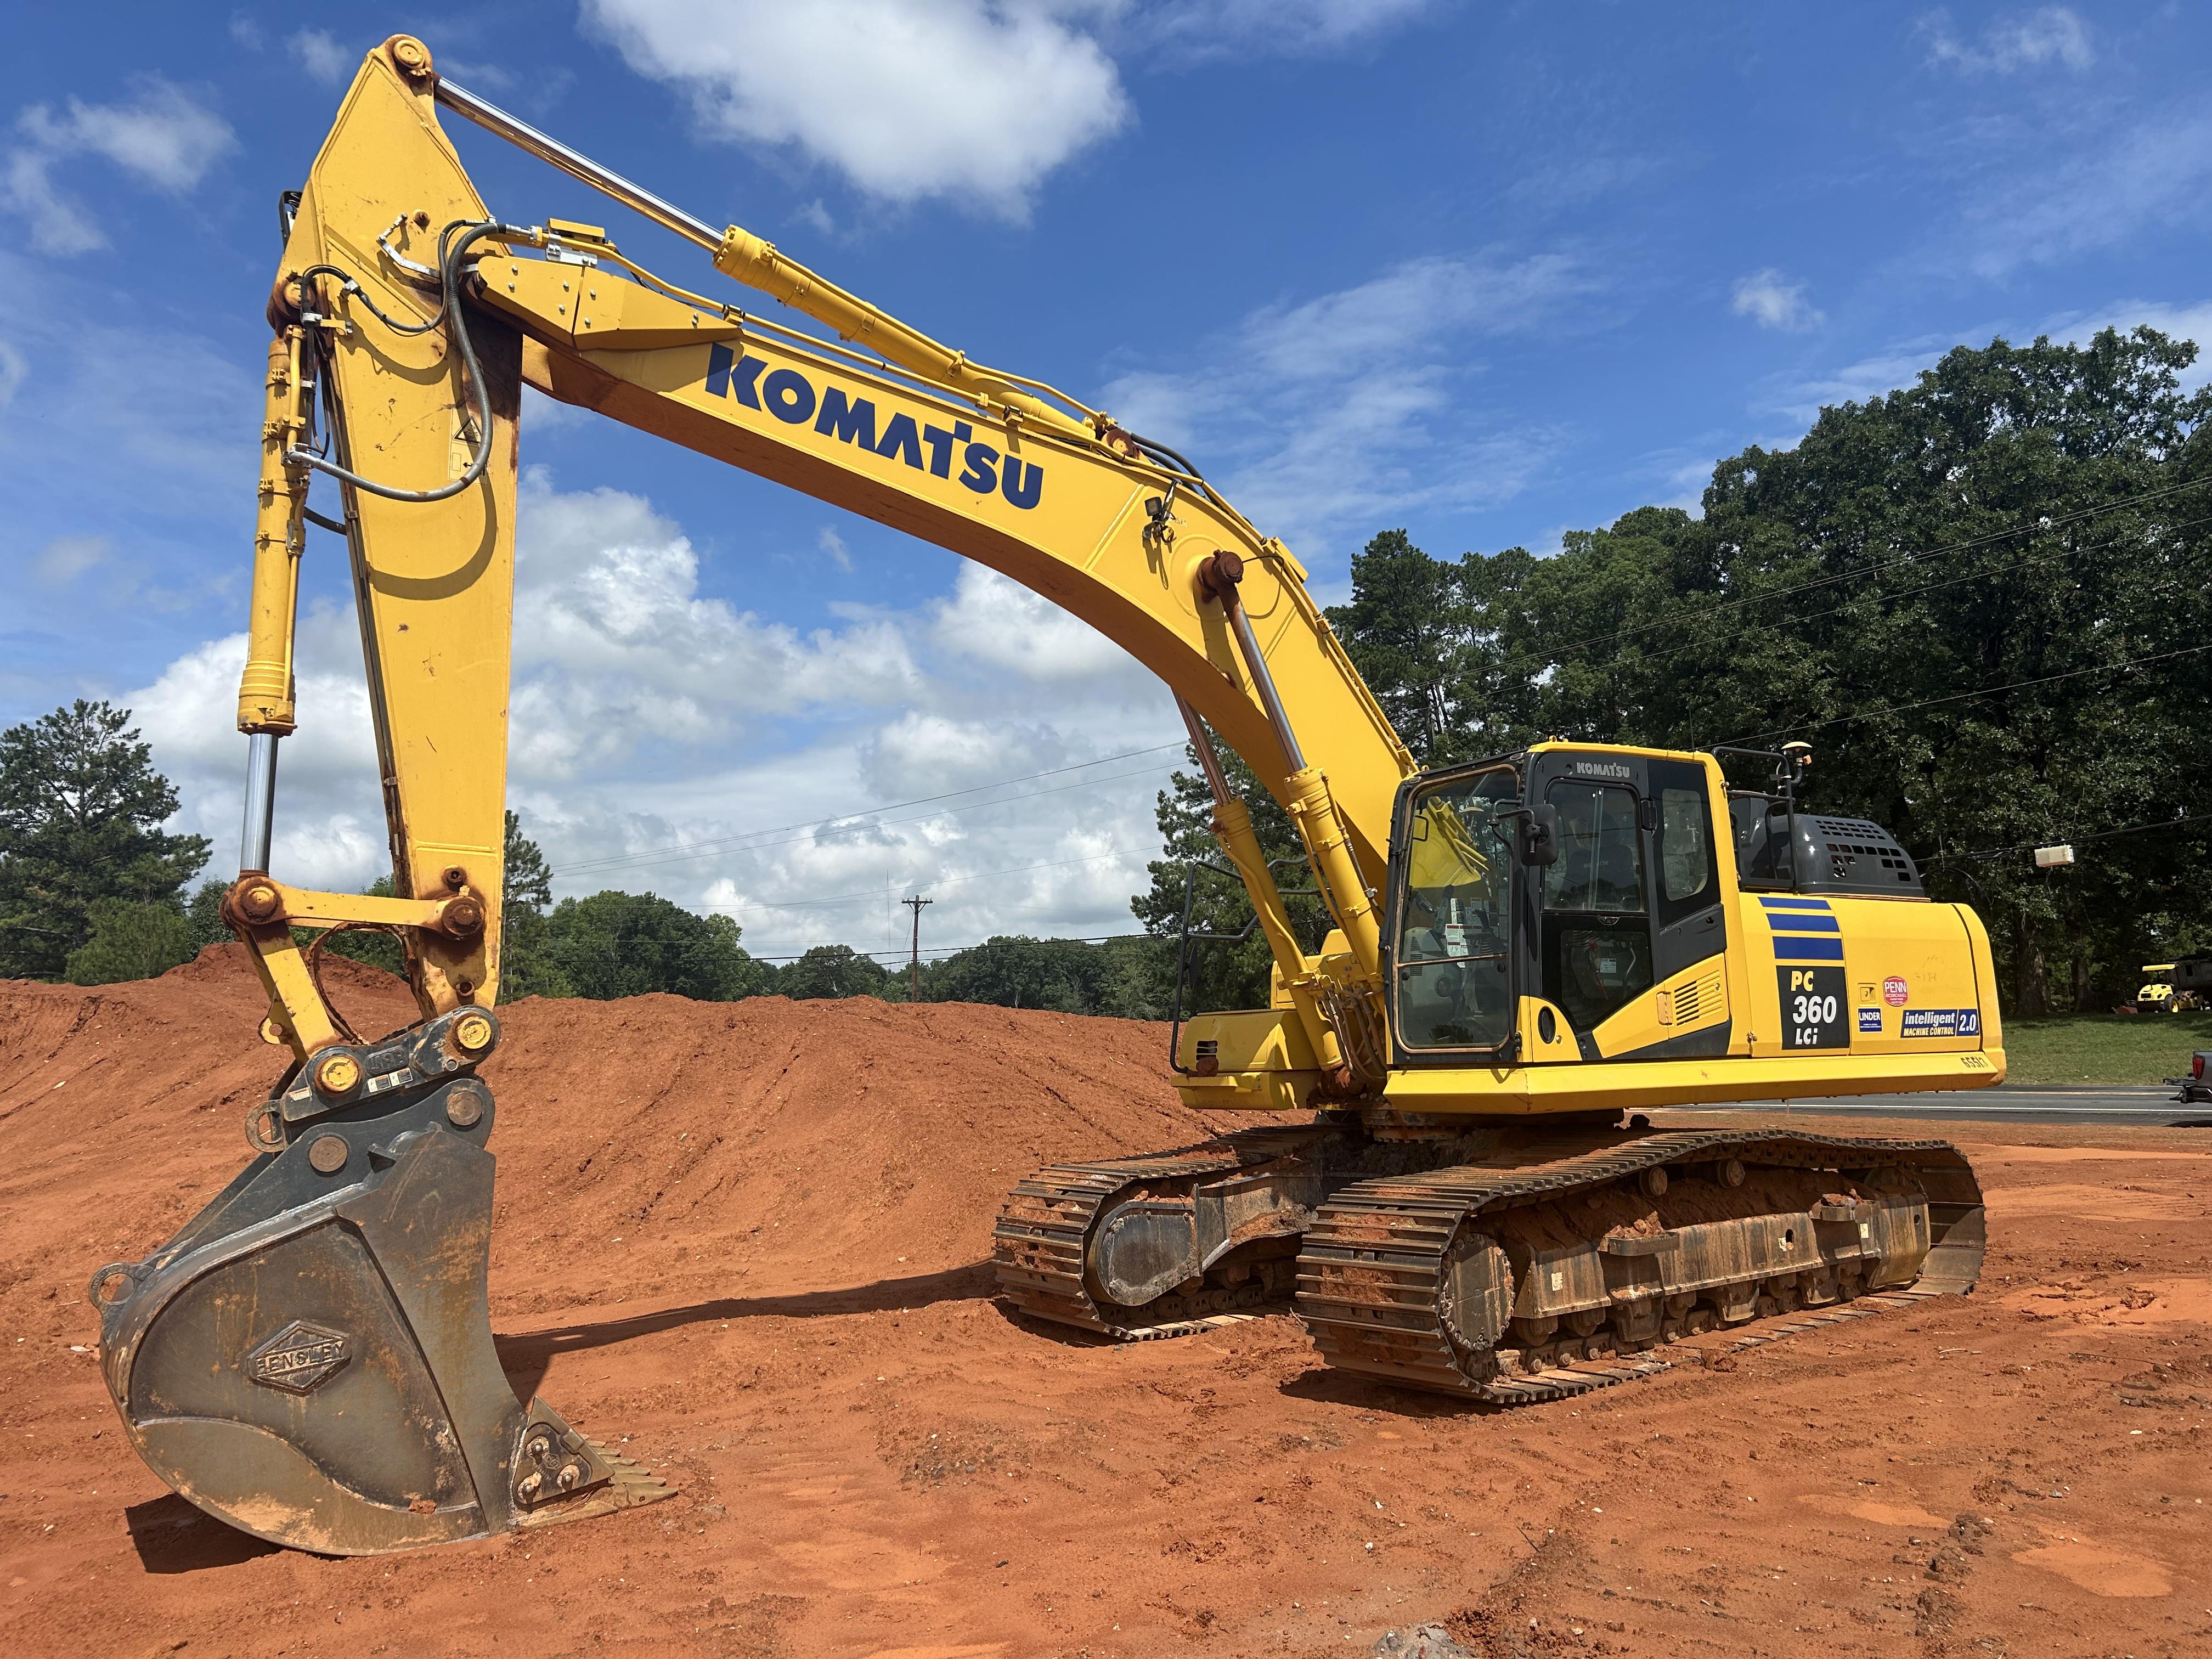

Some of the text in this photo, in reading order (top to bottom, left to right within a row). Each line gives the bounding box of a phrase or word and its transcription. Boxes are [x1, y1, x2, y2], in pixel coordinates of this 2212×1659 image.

[705, 342, 1043, 510] KOMATSU
[1576, 762, 1630, 778] KOMATSU
[1791, 970, 1814, 991] PC
[1884, 981, 1906, 993] PENN
[1792, 996, 1837, 1024] 360
[1905, 1012, 1955, 1026] intelligent
[1959, 1014, 1976, 1031] 2.0
[1795, 1028, 1818, 1045] LCi
[1903, 1026, 1954, 1036] MACHINE CONTROL
